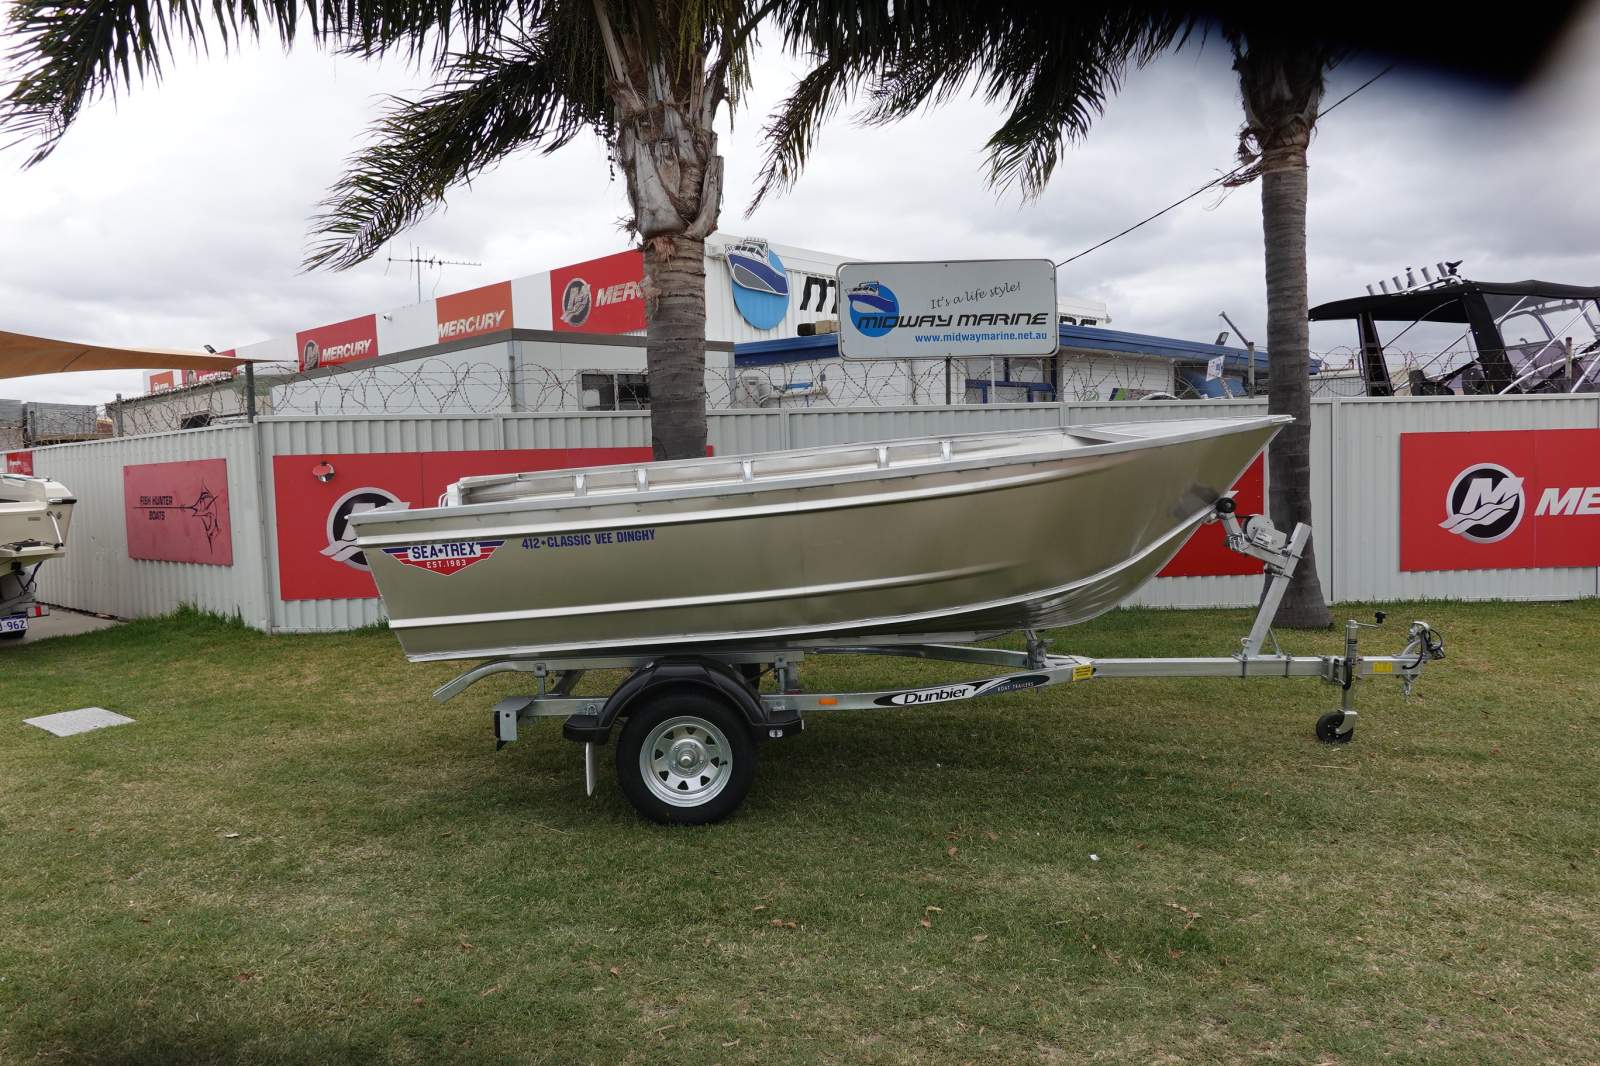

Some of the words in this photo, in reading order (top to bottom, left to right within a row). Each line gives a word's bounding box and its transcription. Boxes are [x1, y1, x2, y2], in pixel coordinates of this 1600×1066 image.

[930, 296, 951, 310] It's
[953, 295, 964, 305] a
[965, 287, 987, 303] life
[990, 281, 1021, 298] style!
[438, 310, 505, 338] MERCURY
[857, 314, 953, 329] MIDWAY
[957, 313, 1049, 327] MARINE
[915, 331, 1047, 343] www.midwaymarine.net.au
[322, 339, 372, 362] MERCURY
[140, 496, 152, 505] FISH
[152, 496, 173, 505] HUNTER
[149, 511, 166, 520] BOATS
[595, 532, 614, 545] VEE
[616, 529, 656, 543] DINGHY
[903, 687, 969, 704] Dunbier
